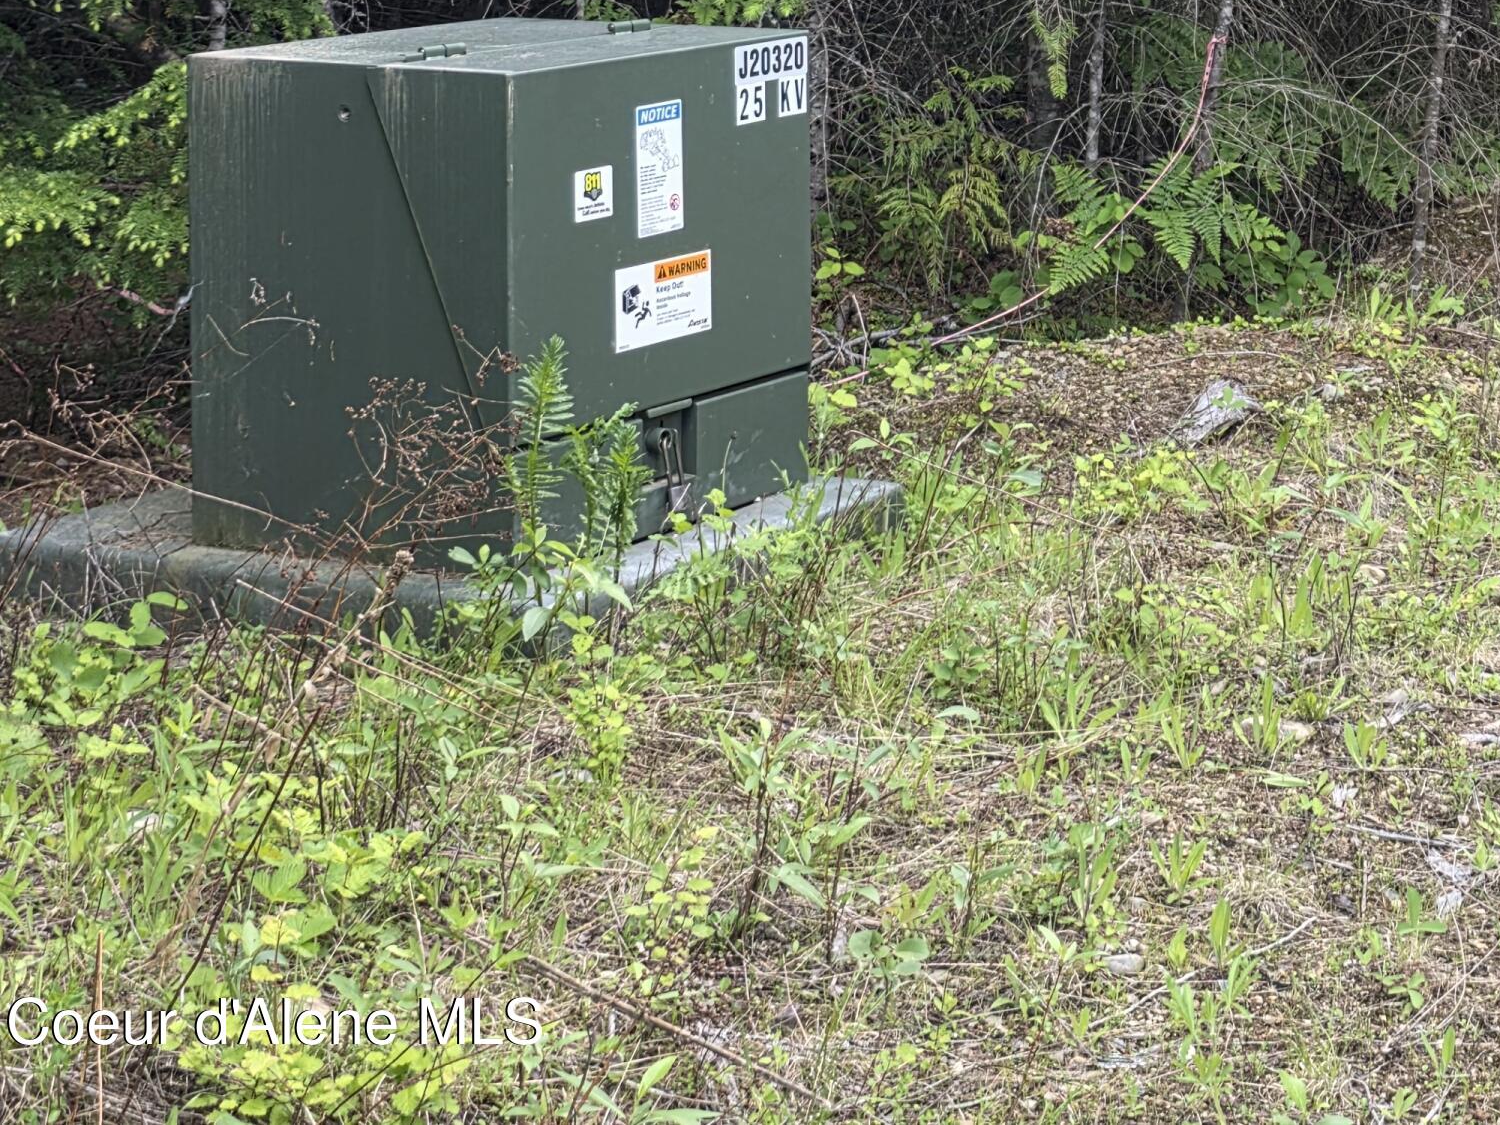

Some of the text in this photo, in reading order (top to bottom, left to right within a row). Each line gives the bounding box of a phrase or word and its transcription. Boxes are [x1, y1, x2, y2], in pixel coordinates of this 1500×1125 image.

[738, 41, 804, 79] J20320
[739, 78, 805, 121] 25 KV
[640, 104, 678, 124] NOTICE
[585, 172, 601, 192] 811
[668, 258, 707, 277] WARNING
[656, 284, 671, 293] Keep
